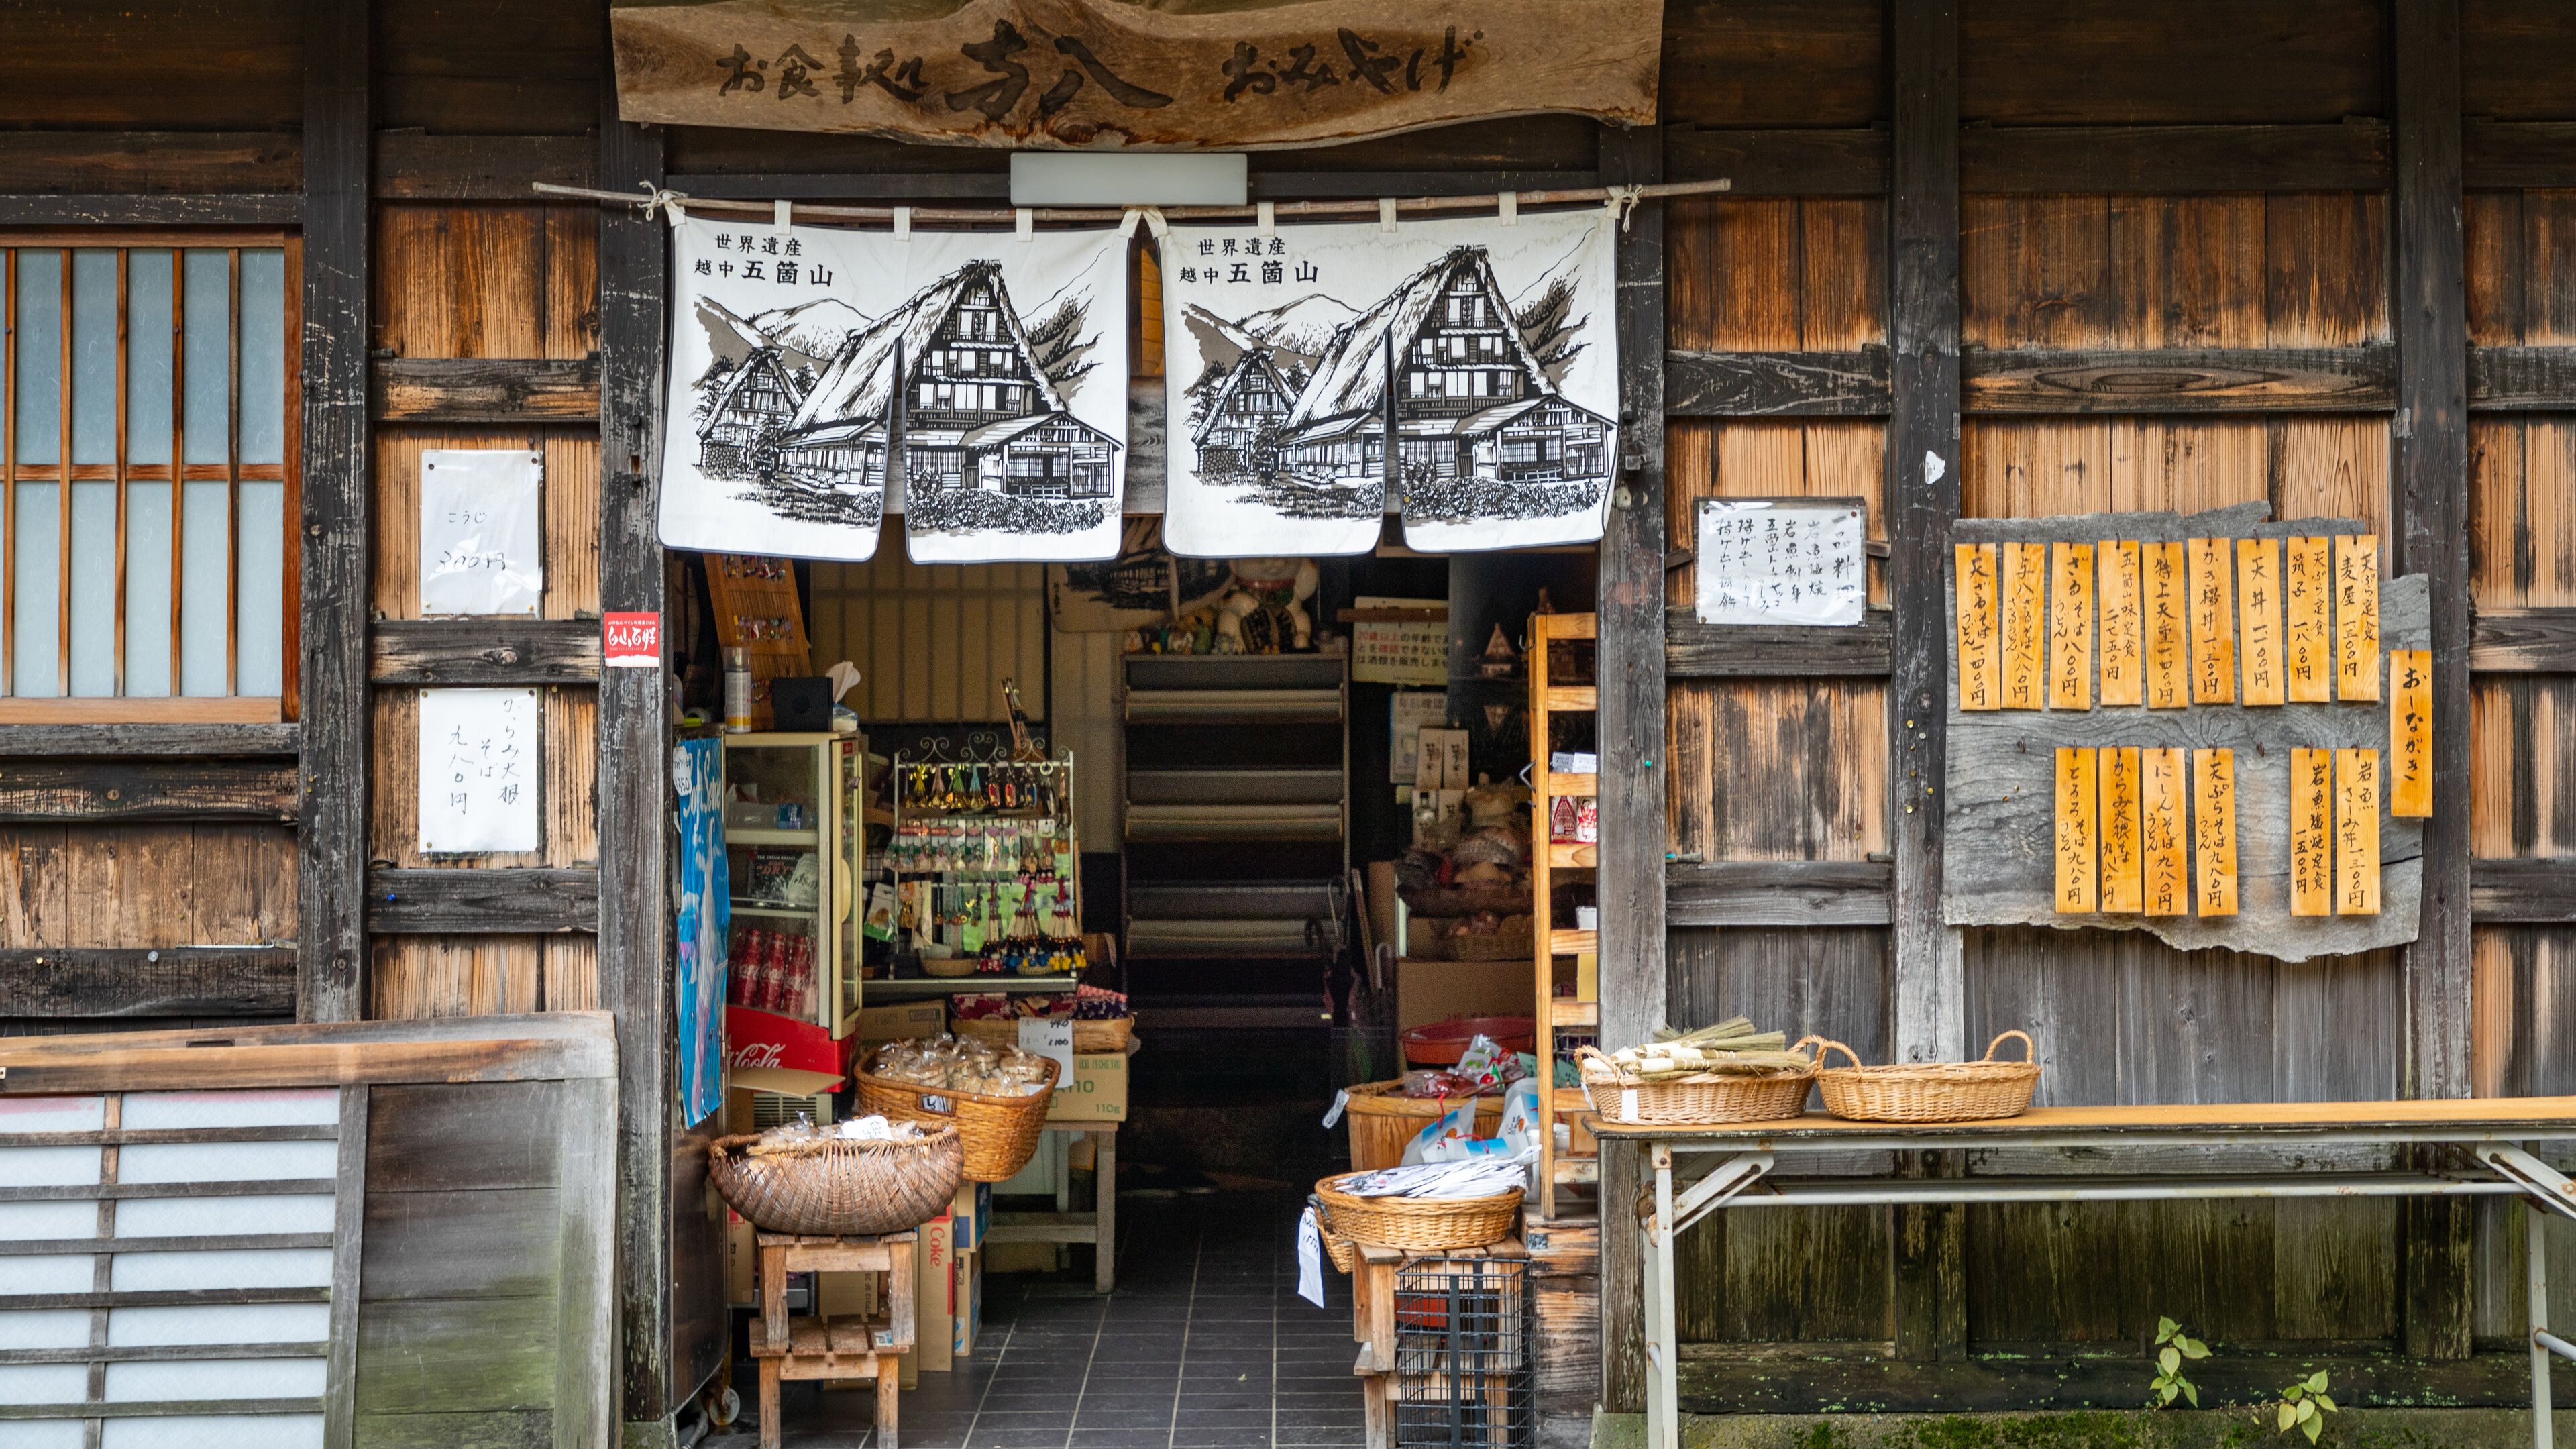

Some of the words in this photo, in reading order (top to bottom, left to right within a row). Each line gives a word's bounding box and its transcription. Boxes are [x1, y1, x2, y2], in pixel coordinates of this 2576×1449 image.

[716, 33, 930, 105] お食事処
[1221, 24, 1485, 104] おみやげ
[714, 233, 802, 257] 世界遺産
[1197, 236, 1286, 258] 世界遺産
[448, 510, 487, 525] こうじ
[2360, 553, 2378, 641] 天ぷら定食
[1962, 609, 1976, 646] うどん
[2054, 599, 2070, 638] うどん
[2402, 667, 2431, 782] おしながき
[480, 739, 499, 778] そば
[498, 698, 521, 806] からみ大根
[2146, 812, 2160, 852] うどん
[2198, 816, 2212, 851] うどん
[930, 1226, 945, 1267] Coke
